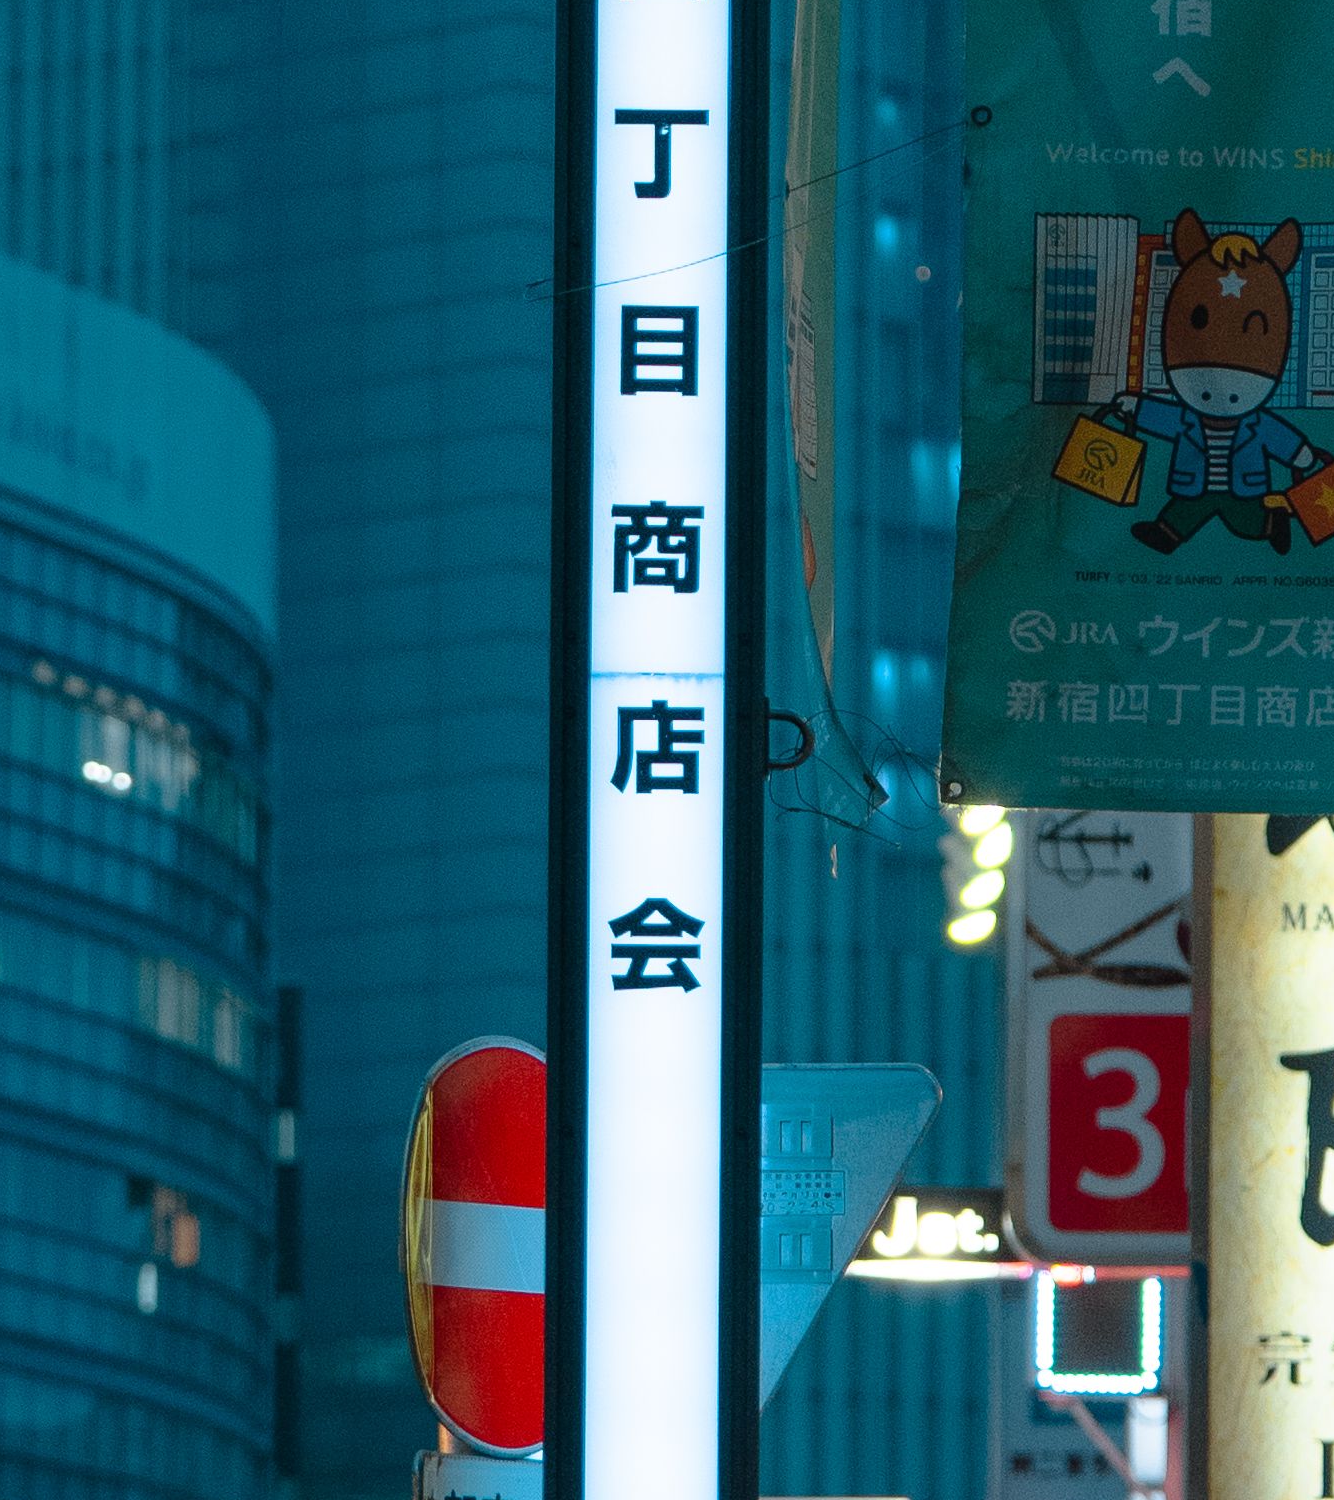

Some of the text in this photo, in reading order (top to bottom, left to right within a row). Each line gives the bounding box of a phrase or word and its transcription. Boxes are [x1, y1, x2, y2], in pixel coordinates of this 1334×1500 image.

[1046, 142, 1167, 168] Welcome
[1179, 146, 1204, 168] to
[1212, 145, 1284, 169] WINS
[1175, 574, 1223, 586] SANRIO
[1061, 621, 1120, 647] JRA
[1076, 1048, 1192, 1199] 3
